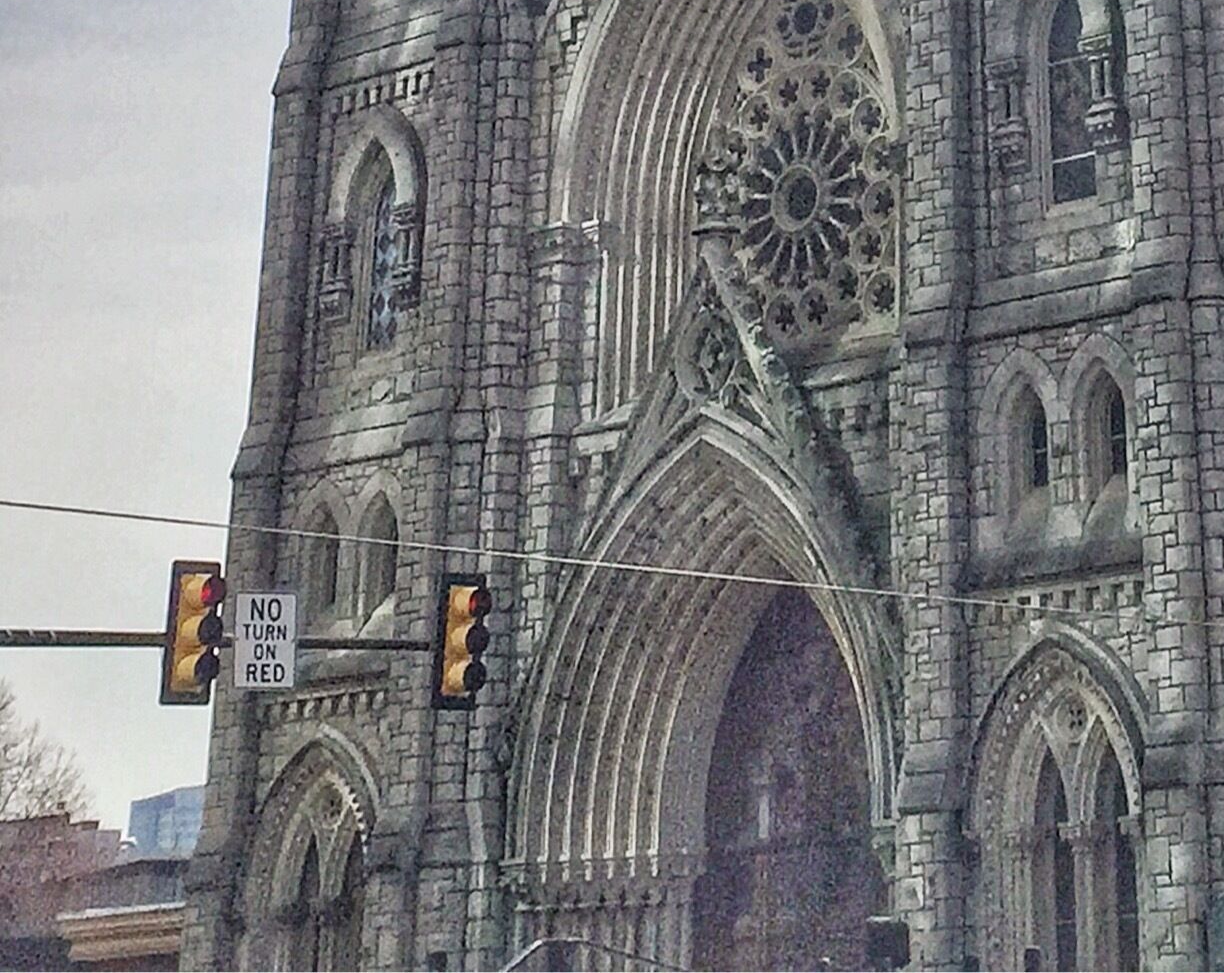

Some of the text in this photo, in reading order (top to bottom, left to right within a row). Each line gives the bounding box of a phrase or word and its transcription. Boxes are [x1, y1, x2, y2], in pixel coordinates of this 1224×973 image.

[250, 598, 282, 622] NO
[243, 623, 287, 641] TURN
[254, 643, 276, 660] ON
[246, 663, 285, 683] RED
